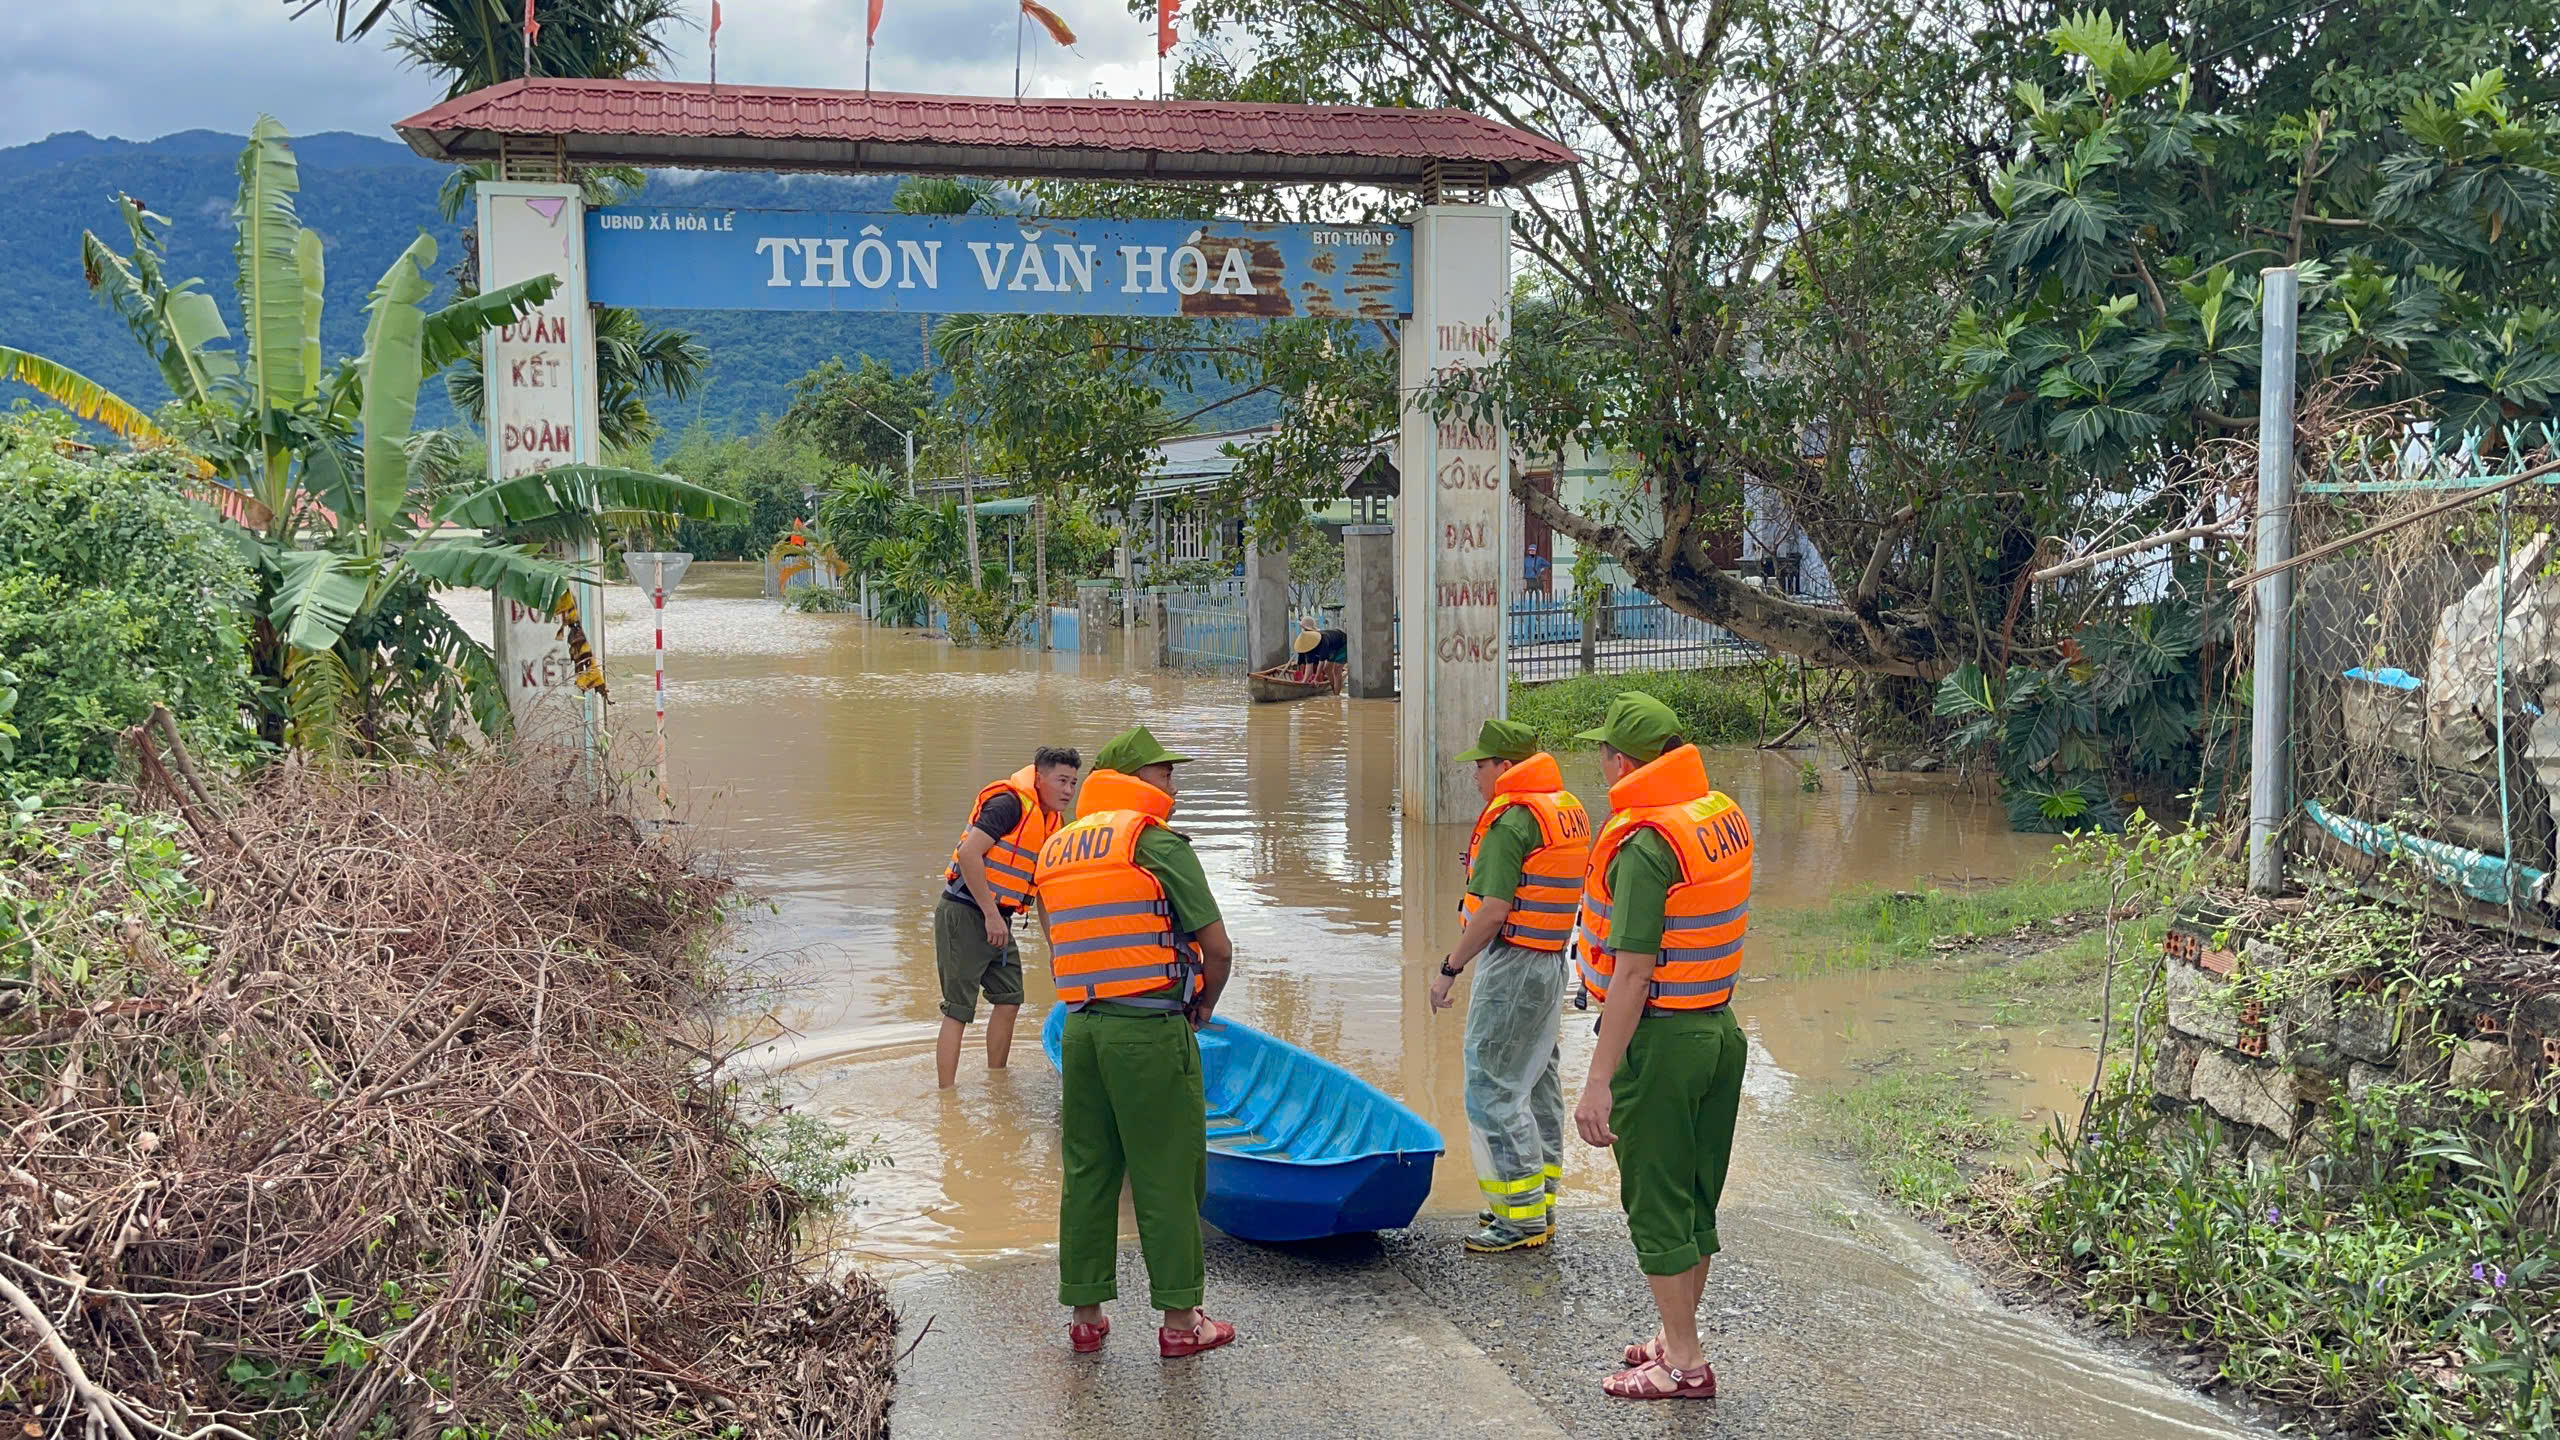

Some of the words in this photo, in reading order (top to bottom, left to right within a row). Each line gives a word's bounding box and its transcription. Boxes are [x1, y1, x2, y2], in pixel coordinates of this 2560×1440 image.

[600, 215, 644, 230] UBND
[649, 212, 671, 231] XÃ
[675, 213, 708, 231] HÒA
[1313, 231, 1341, 247] BTQ
[1343, 229, 1382, 246] THÔN
[1385, 232, 1395, 246] 9
[756, 223, 943, 290] THÔN
[967, 229, 1097, 293] VĂN
[1120, 230, 1258, 296] HÓA
[511, 350, 560, 388] KẾT
[1439, 455, 1500, 490] CÔNG
[1438, 630, 1498, 663] CÔNG
[521, 648, 573, 688] KẾT
[1044, 827, 1113, 868] CAND
[1696, 810, 1749, 863] CAND
